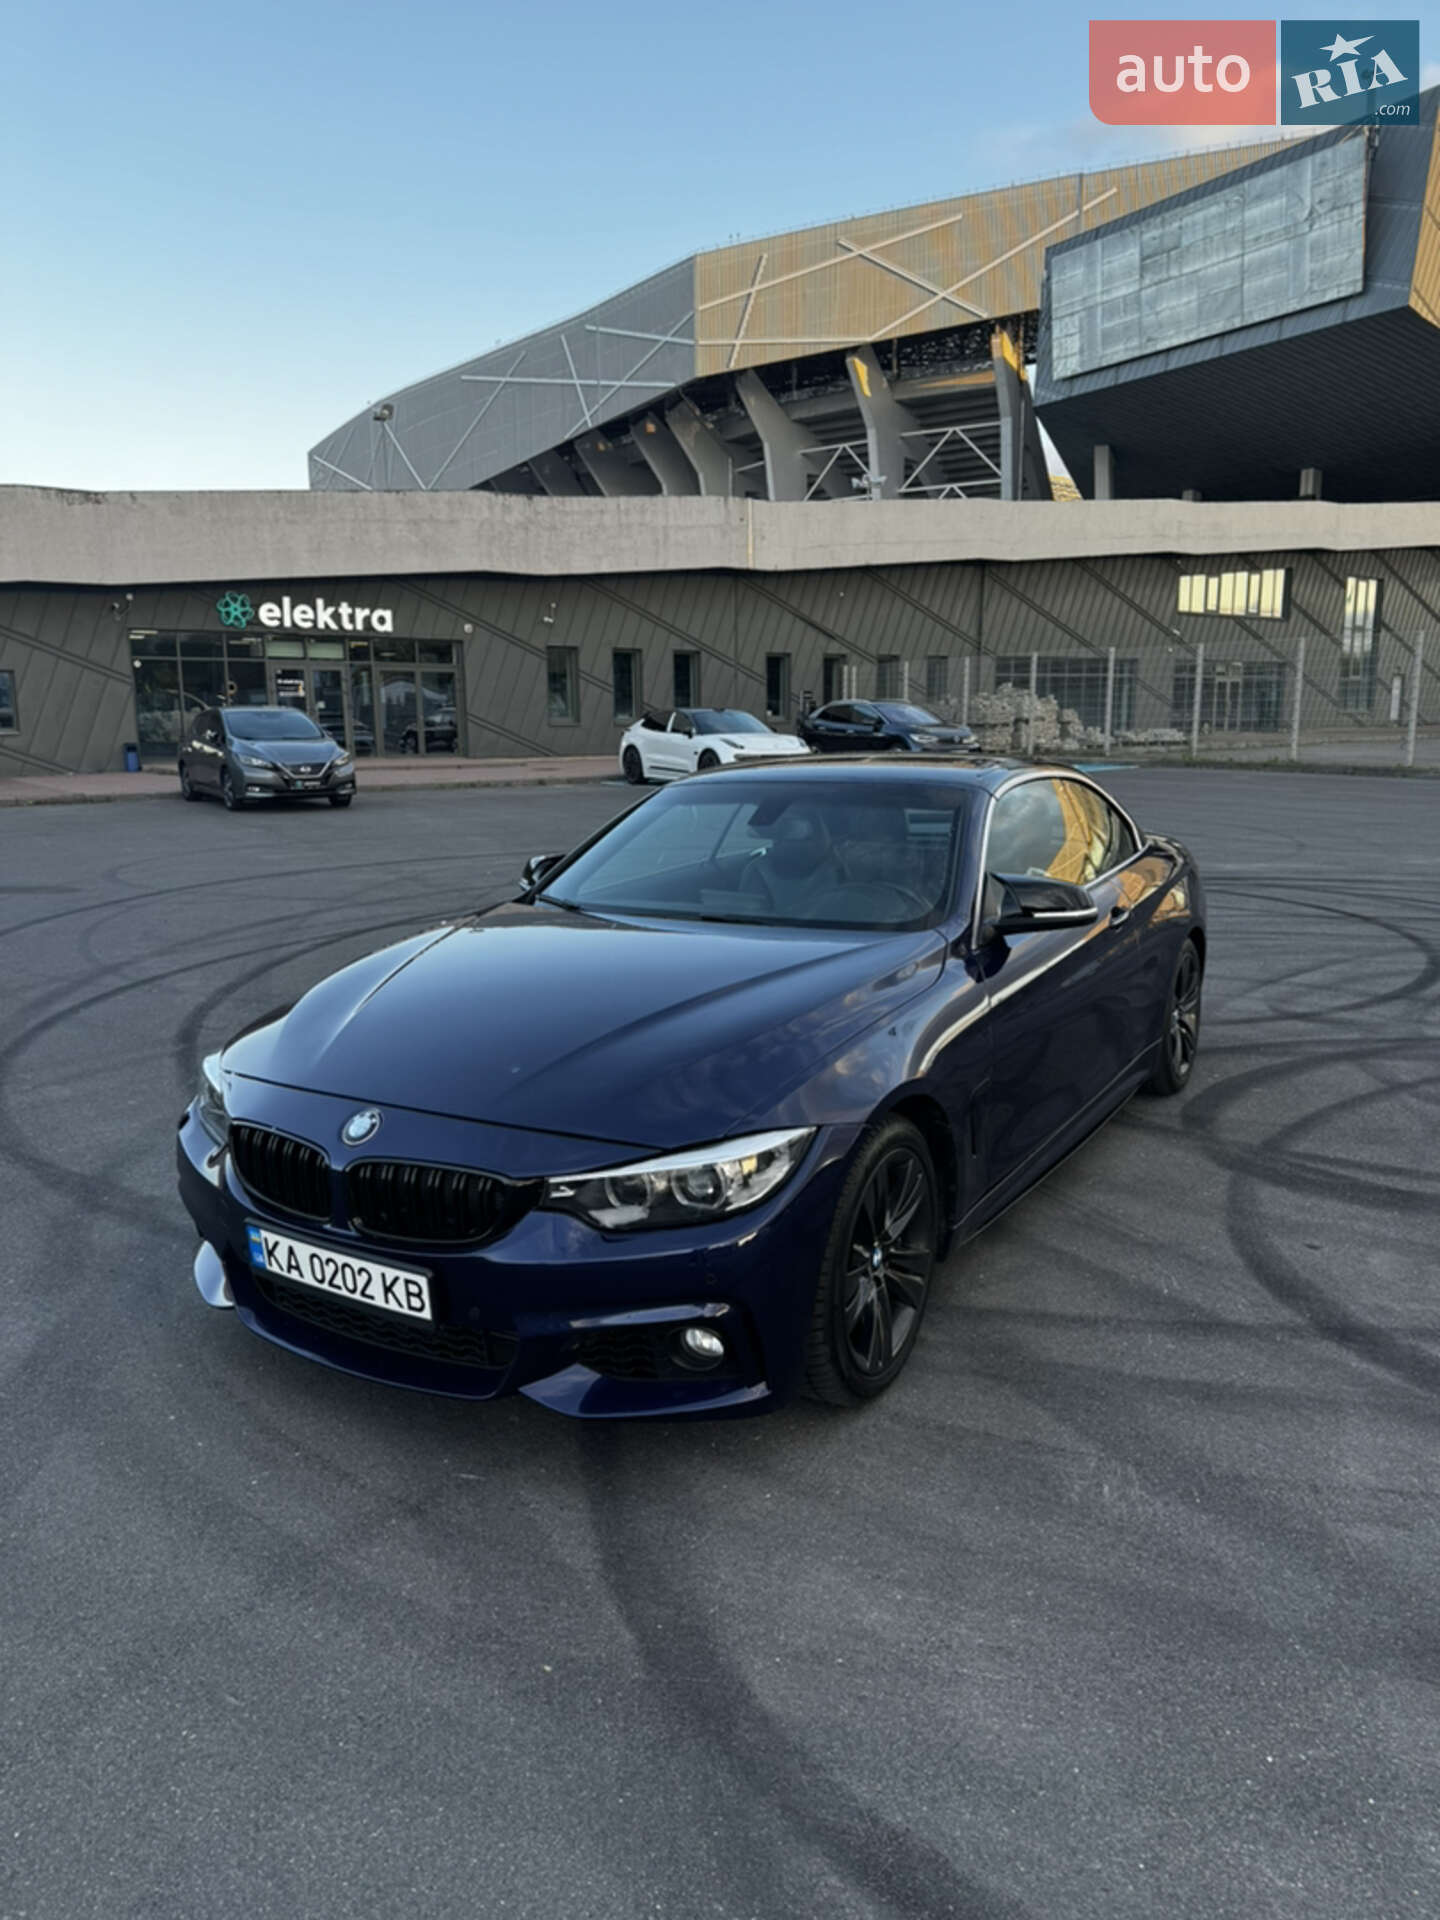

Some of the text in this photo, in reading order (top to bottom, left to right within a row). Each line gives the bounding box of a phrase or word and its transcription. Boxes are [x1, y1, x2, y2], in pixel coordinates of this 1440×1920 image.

[258, 596, 393, 632] elektra
[264, 1237, 426, 1313] KA 0202 KB
